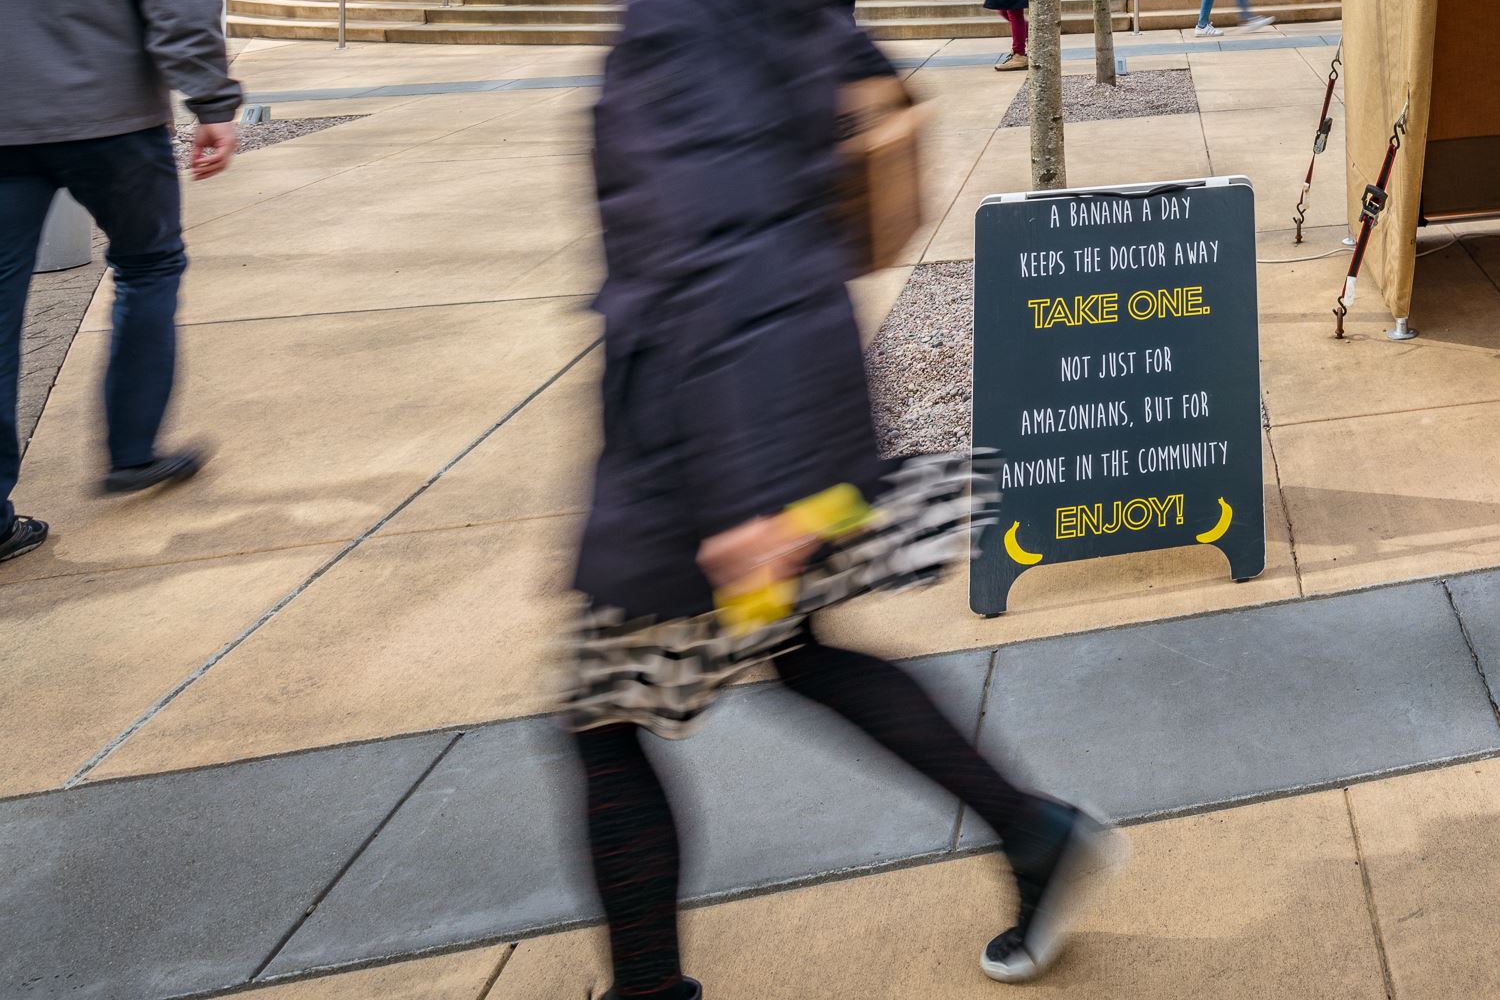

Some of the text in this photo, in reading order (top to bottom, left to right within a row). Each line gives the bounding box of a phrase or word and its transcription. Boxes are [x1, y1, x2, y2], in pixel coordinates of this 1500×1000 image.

[1050, 196, 1191, 228] A BANANA A DAY
[1020, 240, 1219, 278] KEEPS THE DOCTOR AWAY
[1028, 286, 1210, 328] TAKE ONE.
[1061, 347, 1172, 382] NOT JUST FOR
[1021, 391, 1209, 436] AMAZONIANS, BUT FOR
[1002, 441, 1228, 489] ANYONE IN THE COMMUNITY
[1055, 493, 1184, 540] ENJOY!
